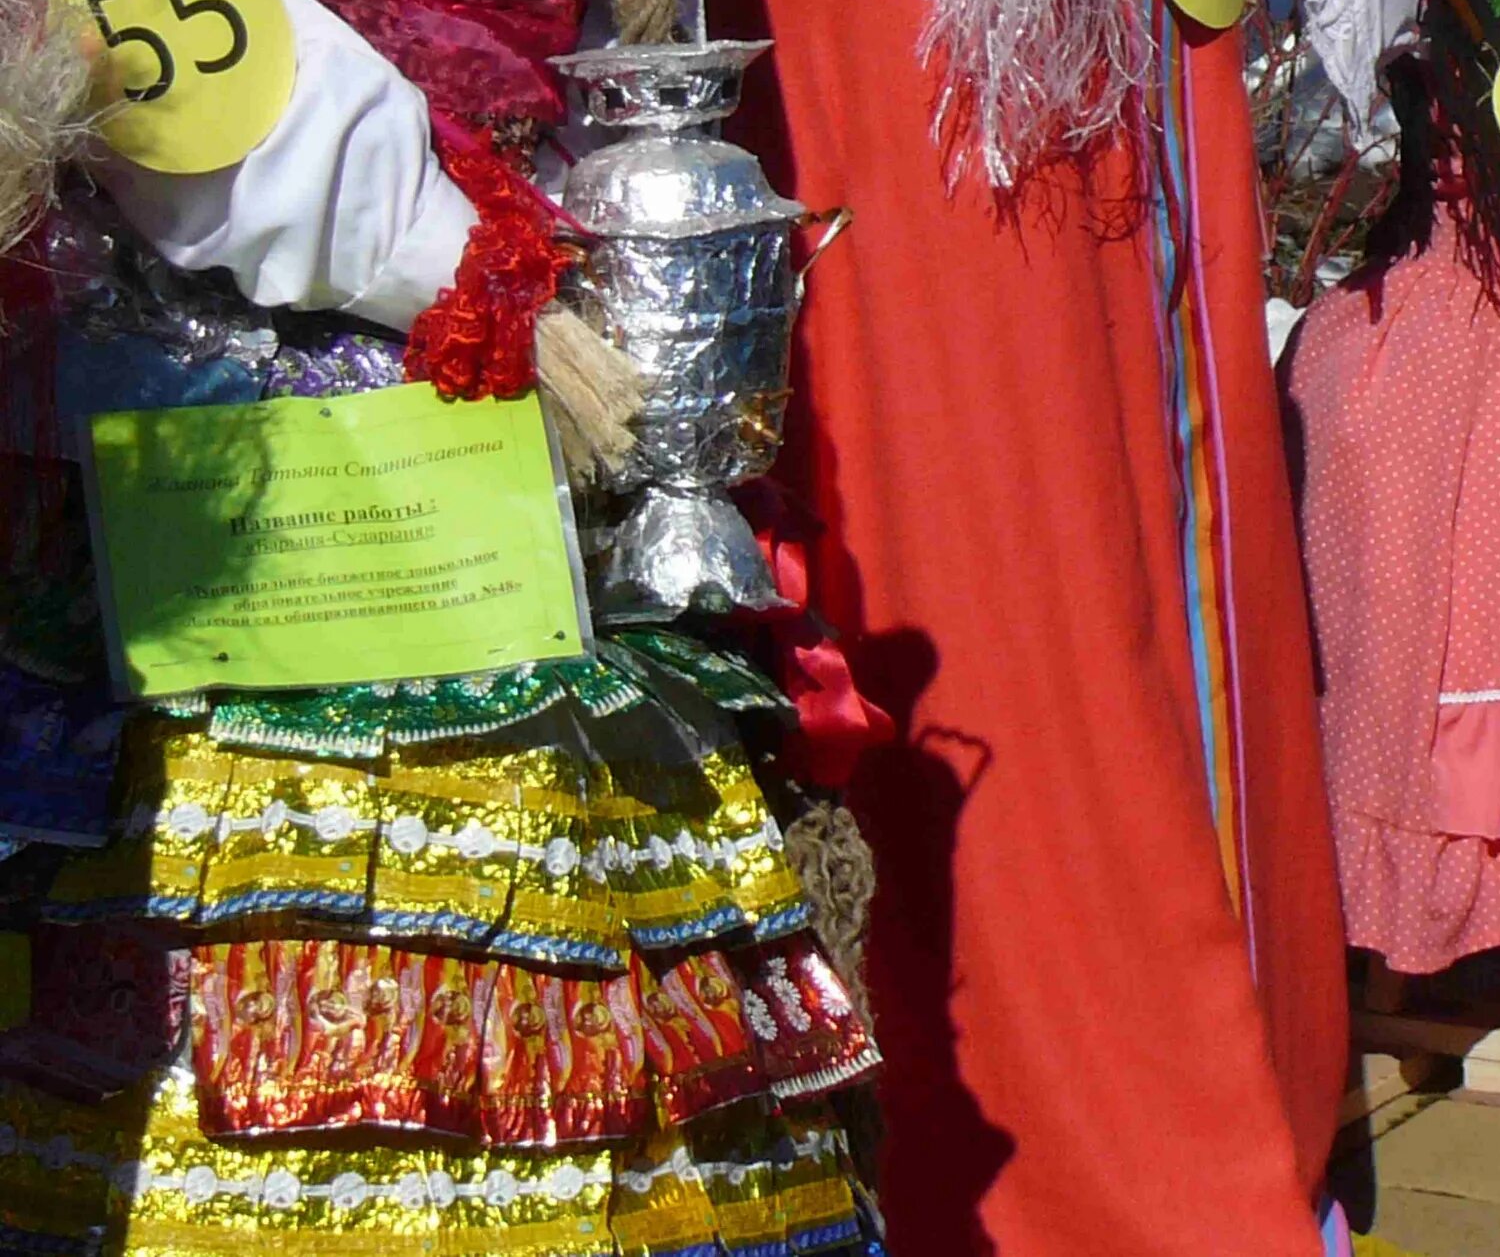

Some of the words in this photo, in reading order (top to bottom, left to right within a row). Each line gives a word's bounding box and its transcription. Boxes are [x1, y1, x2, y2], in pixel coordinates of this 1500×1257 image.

[251, 464, 338, 485] Татьяна
[344, 440, 505, 478] Станиславовна
[229, 509, 337, 537] Название
[344, 502, 424, 525] работы
